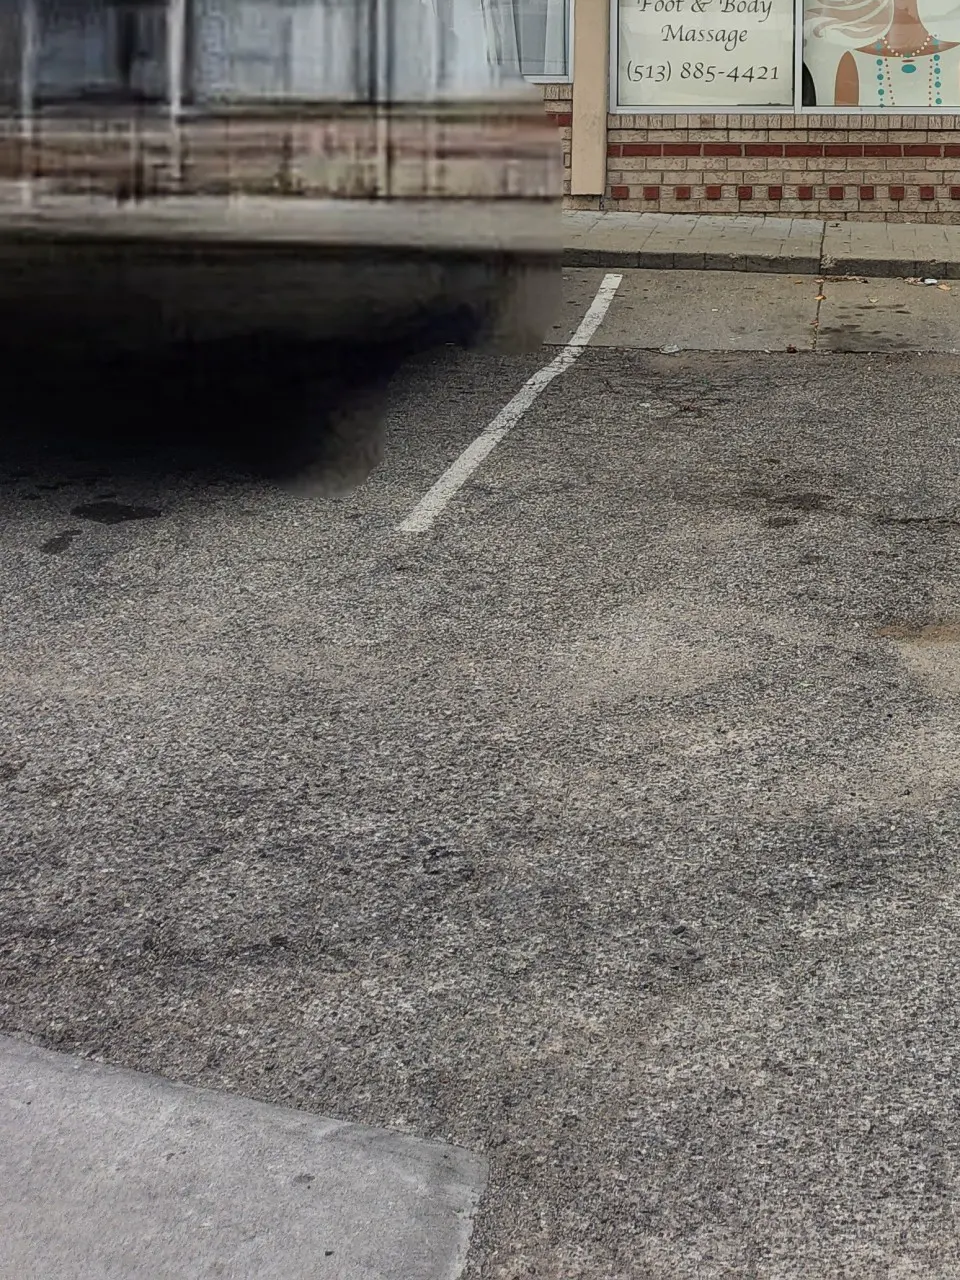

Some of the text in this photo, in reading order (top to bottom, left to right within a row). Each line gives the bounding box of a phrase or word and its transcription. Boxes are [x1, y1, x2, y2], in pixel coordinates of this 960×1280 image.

[660, 24, 748, 52] Massage
[627, 60, 779, 83] (513) 885-4421
